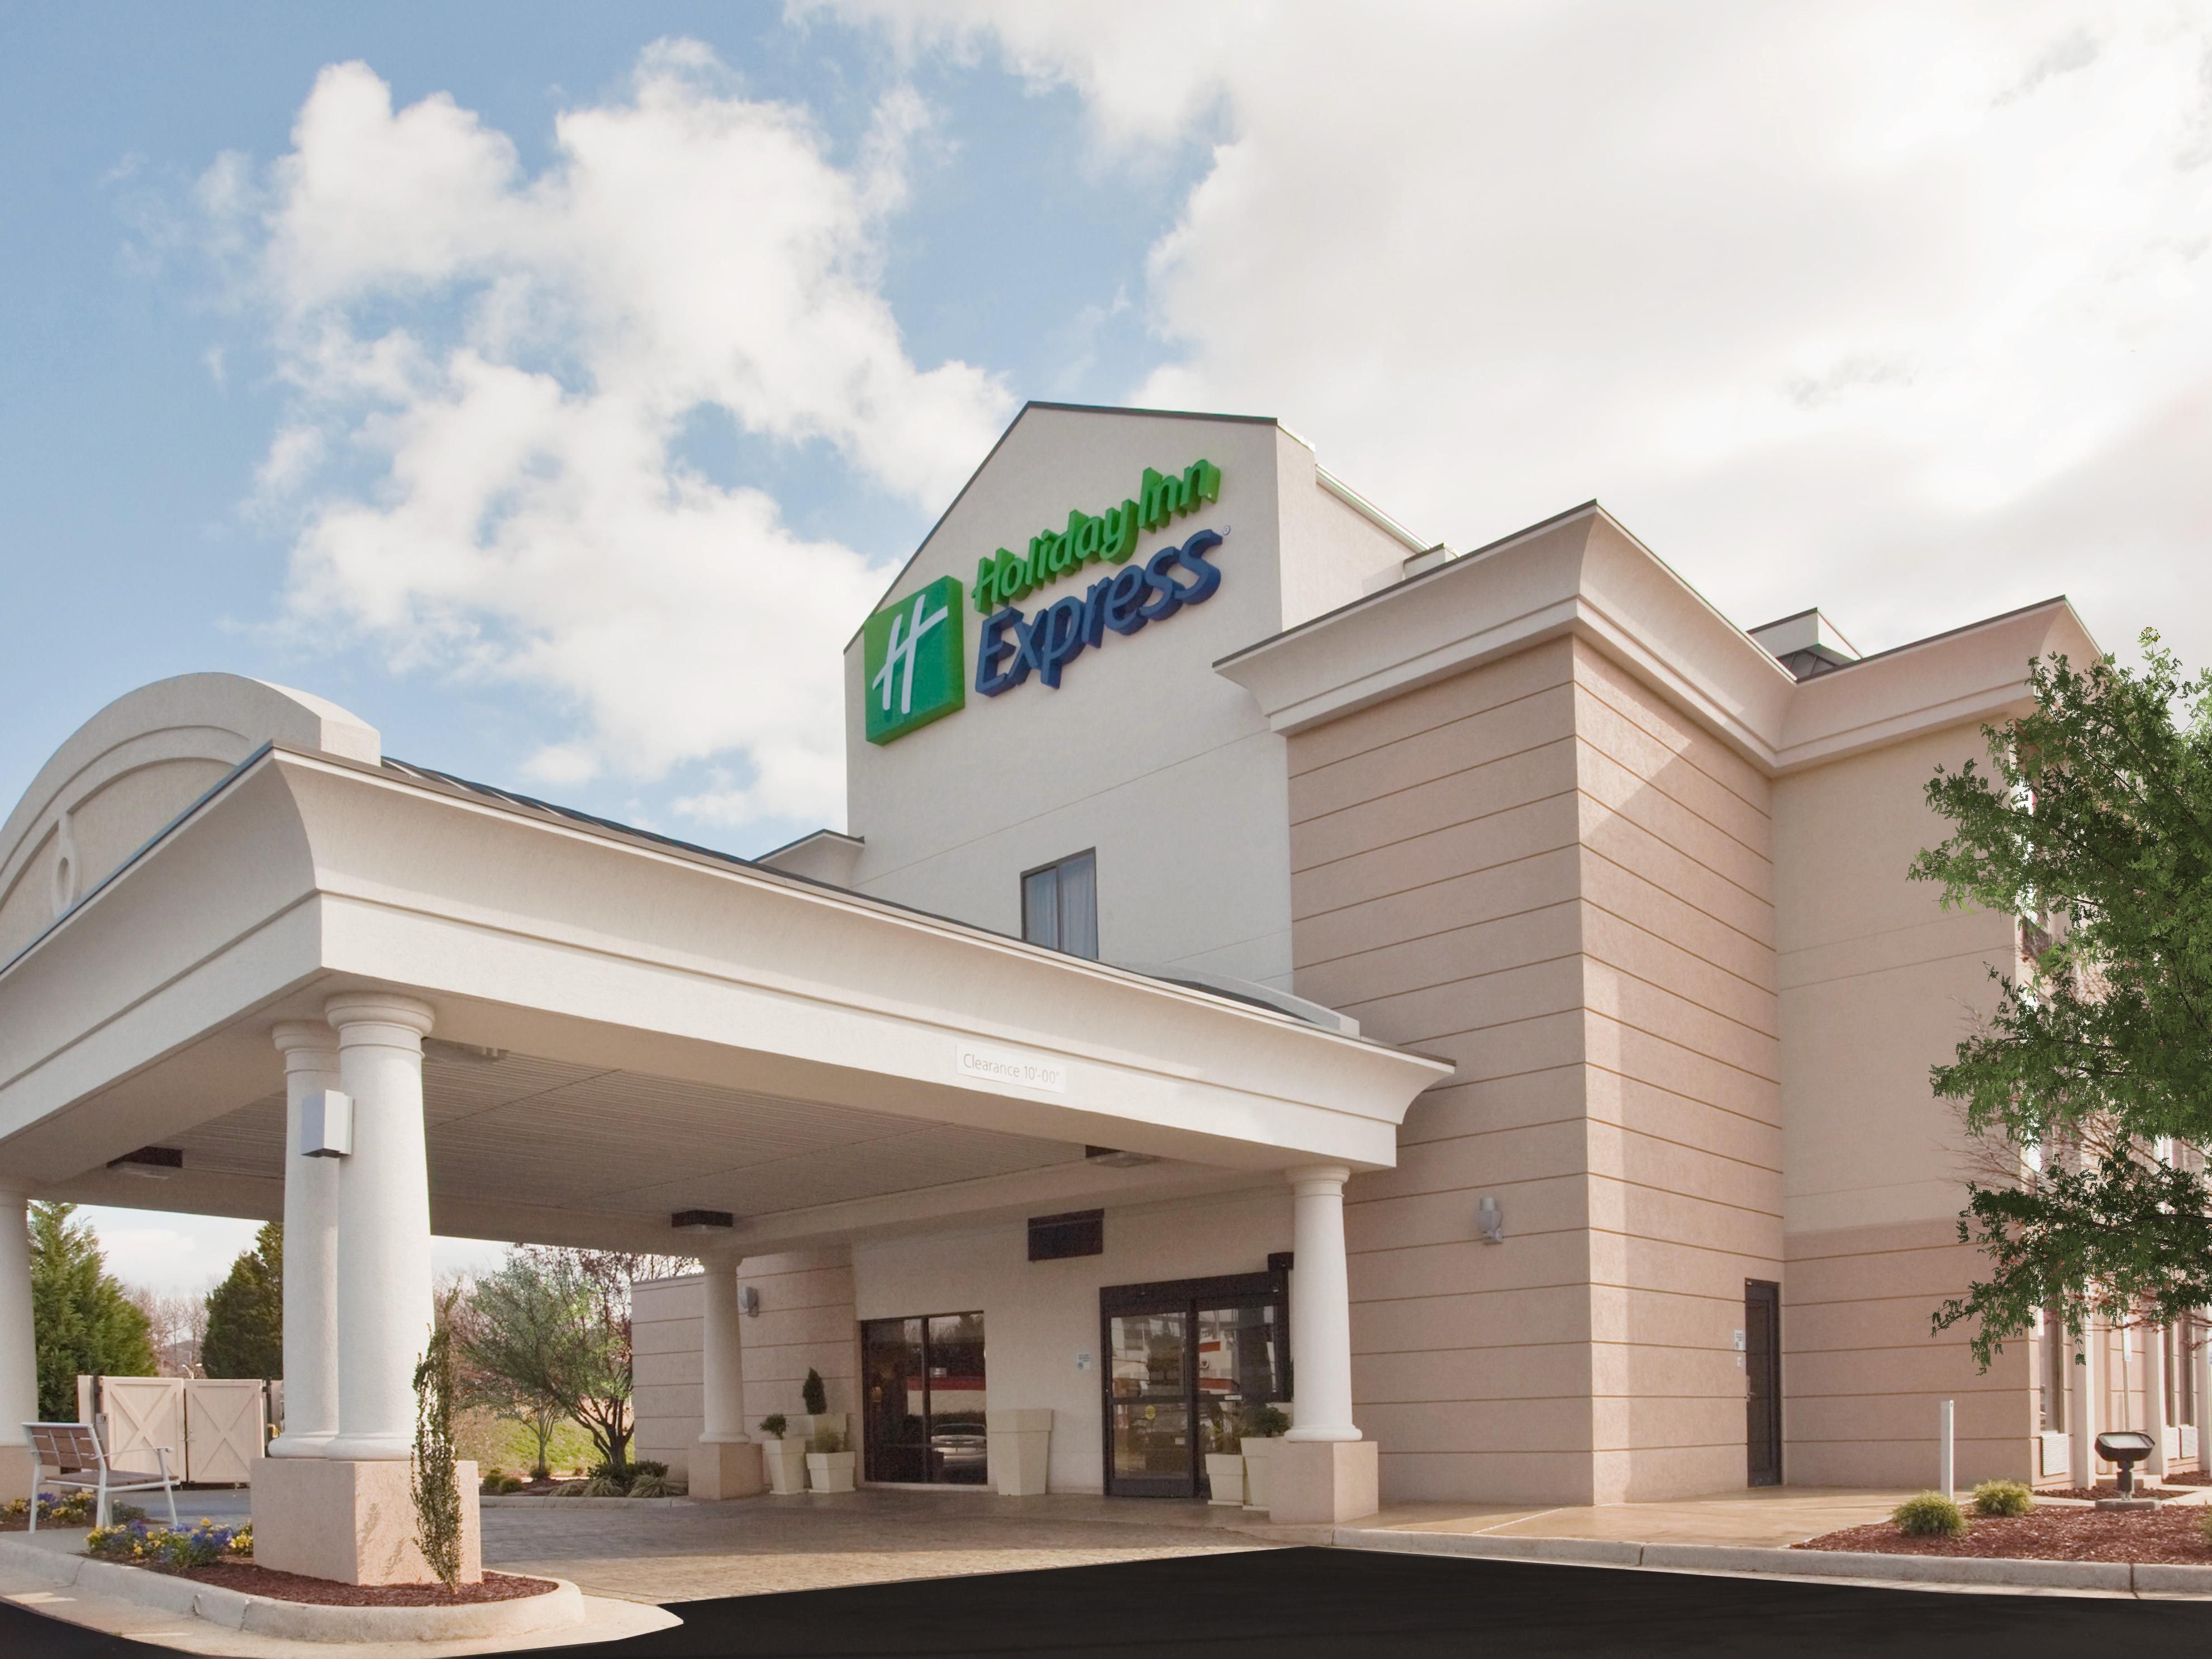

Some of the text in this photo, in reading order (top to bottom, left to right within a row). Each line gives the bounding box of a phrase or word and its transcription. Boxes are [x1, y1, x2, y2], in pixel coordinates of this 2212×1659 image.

[971, 459, 1221, 616] Holiday Inn
[974, 529, 1223, 698] Express
[963, 1053, 1020, 1078] Clearance
